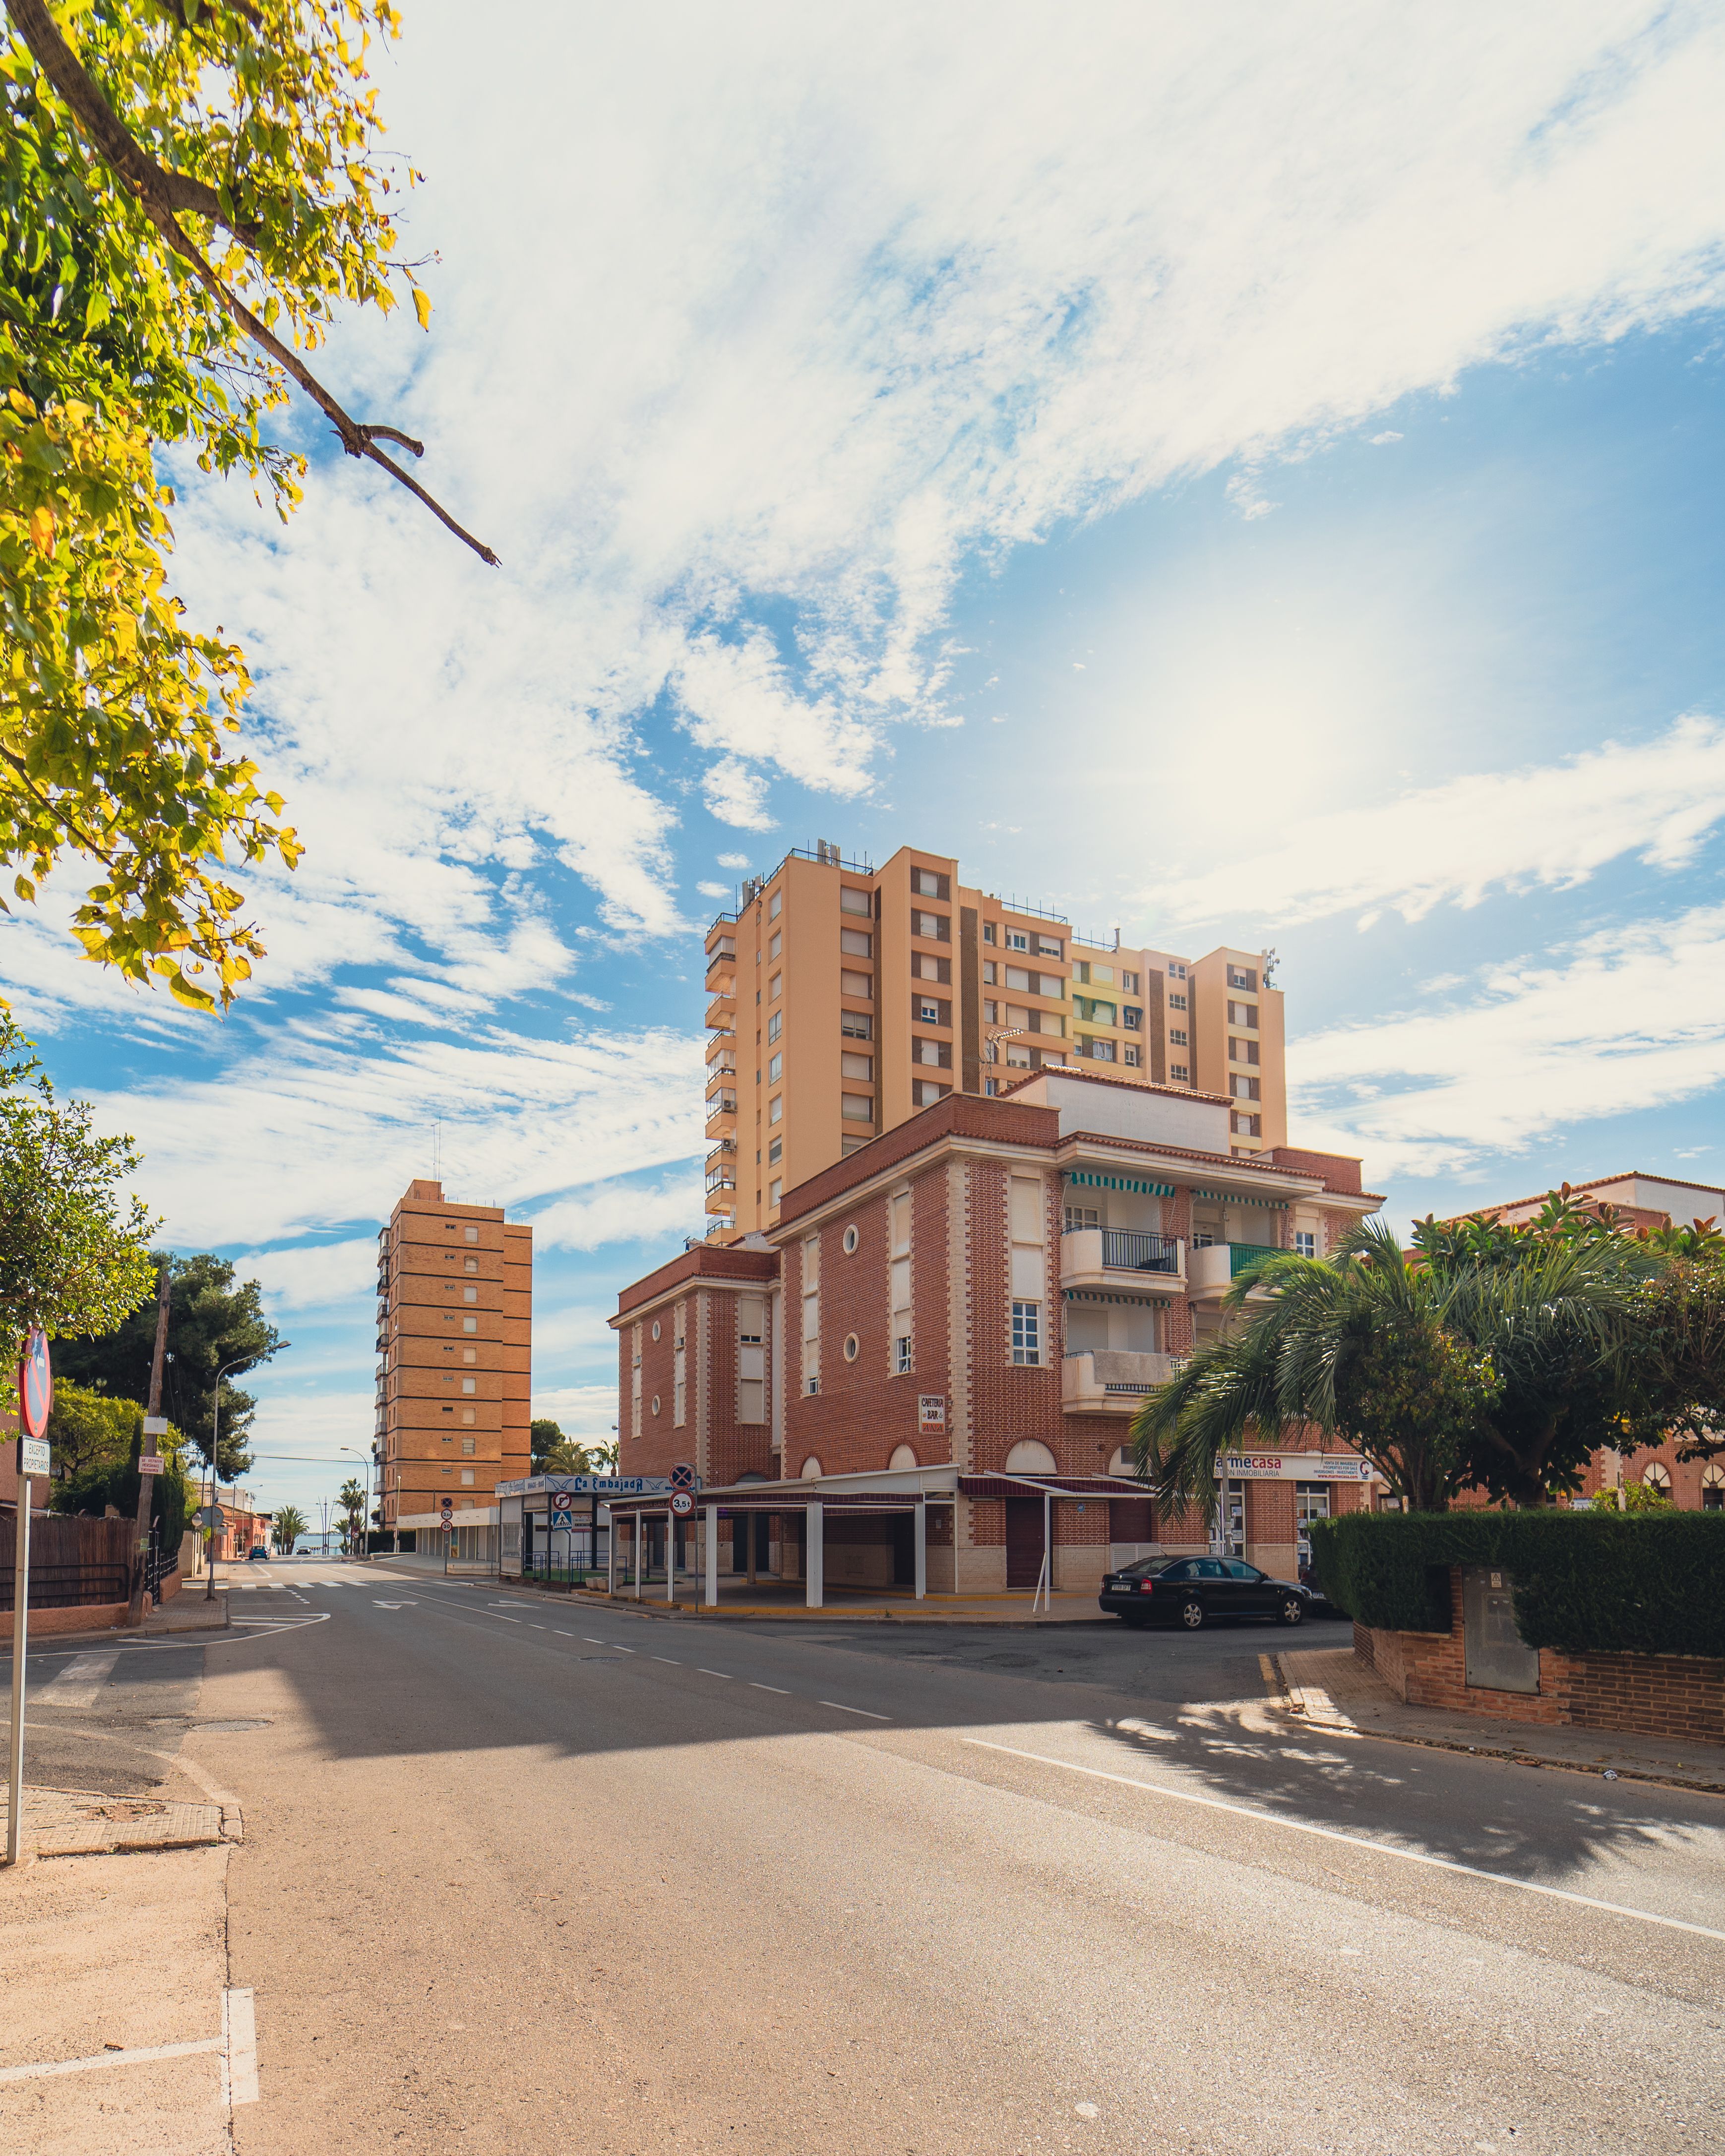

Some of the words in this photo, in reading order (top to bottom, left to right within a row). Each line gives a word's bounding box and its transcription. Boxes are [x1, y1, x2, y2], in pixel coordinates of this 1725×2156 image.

[922, 1397, 943, 1407] CAFETERIA
[927, 1410, 938, 1419] BAR
[924, 1424, 942, 1432] ANA
[29, 1443, 45, 1456] EXCEPTO
[24, 1458, 49, 1471] PROPIETARIOS
